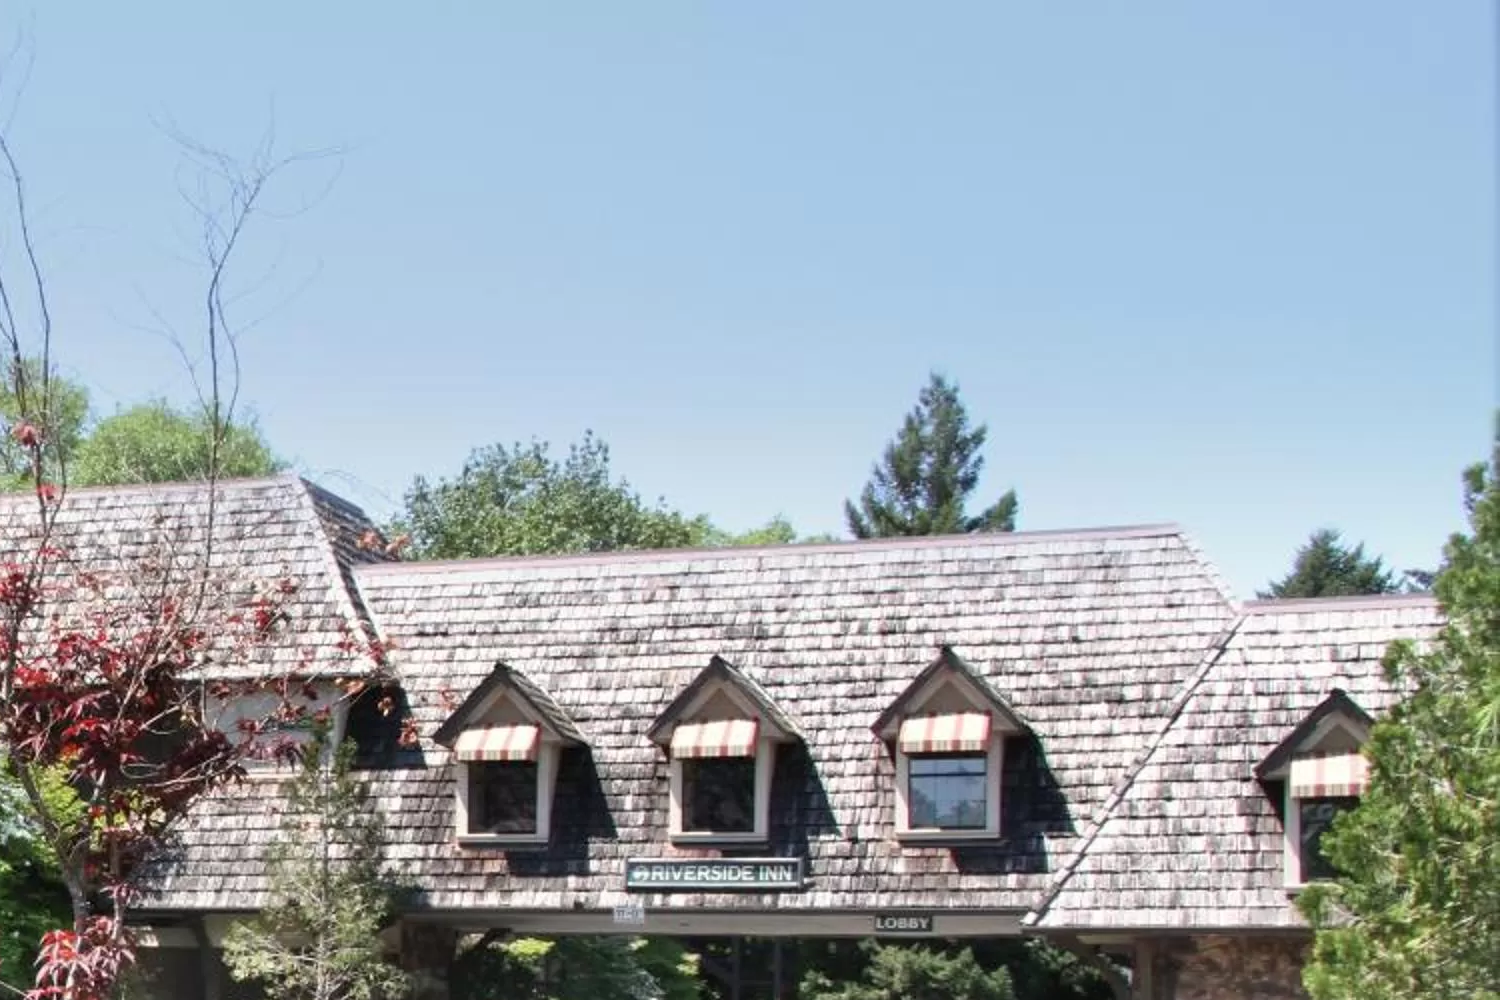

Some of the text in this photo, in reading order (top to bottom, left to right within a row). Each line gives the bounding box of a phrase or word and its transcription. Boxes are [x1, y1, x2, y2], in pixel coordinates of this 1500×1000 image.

[651, 865, 793, 881] RIVERSIDE INN
[876, 917, 929, 929] LOBBY
